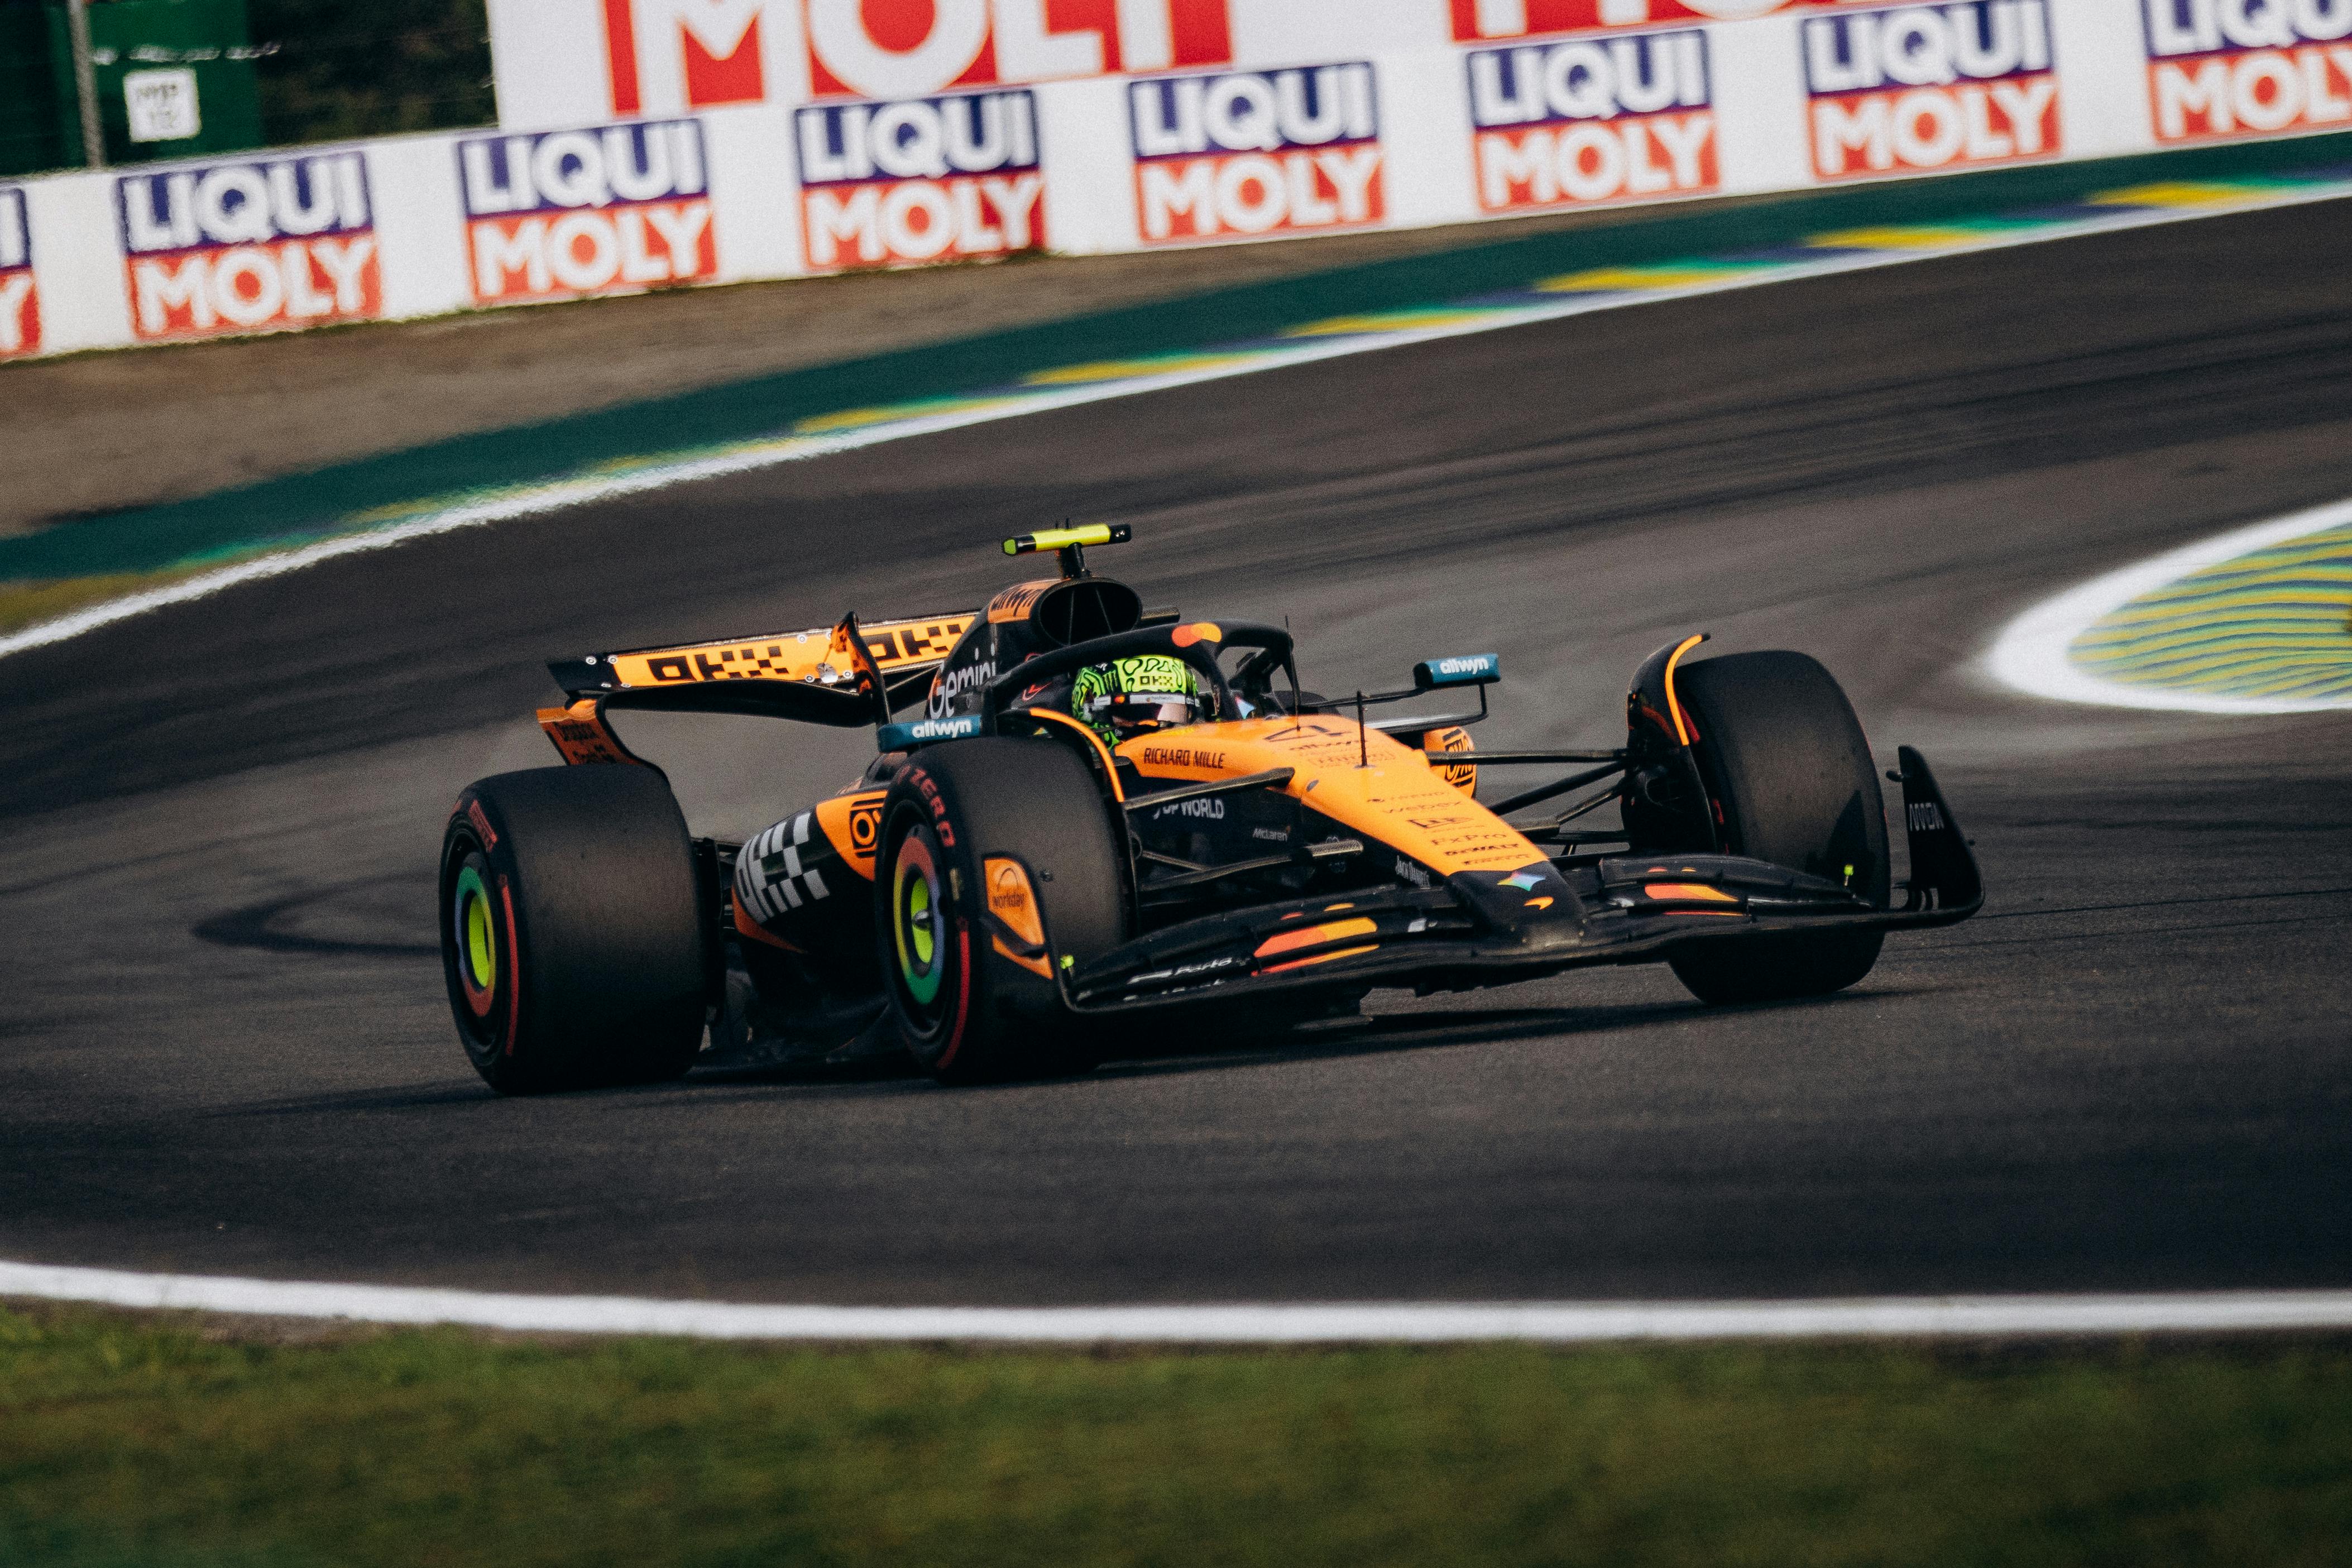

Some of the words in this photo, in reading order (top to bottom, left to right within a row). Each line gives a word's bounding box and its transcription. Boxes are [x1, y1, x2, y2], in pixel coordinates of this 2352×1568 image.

[1472, 30, 1709, 127] LIQUI
[1807, 0, 2049, 94] LIQUI
[801, 89, 1036, 184] LIQUI
[1134, 63, 1373, 156] LIQUI
[1816, 79, 2058, 178] MOLY
[124, 154, 370, 254] LIQUI
[462, 119, 703, 215] LIQUI
[1141, 147, 1382, 239] MOLY
[1481, 116, 1716, 208] MOLY
[472, 205, 713, 297] MOLY
[807, 174, 1043, 266] MOLY
[135, 237, 377, 335] MOLY
[646, 646, 789, 680] OKX
[928, 642, 997, 719] Gemini
[1140, 675, 1173, 686] OKX
[1440, 656, 1489, 674] allwyn
[912, 719, 971, 738] allwyn
[1143, 747, 1190, 766] RICHARD
[1193, 750, 1225, 769] MILLE
[1181, 798, 1225, 819] WORLD
[1253, 828, 1287, 842] McLaren
[1431, 833, 1507, 846] FxPro
